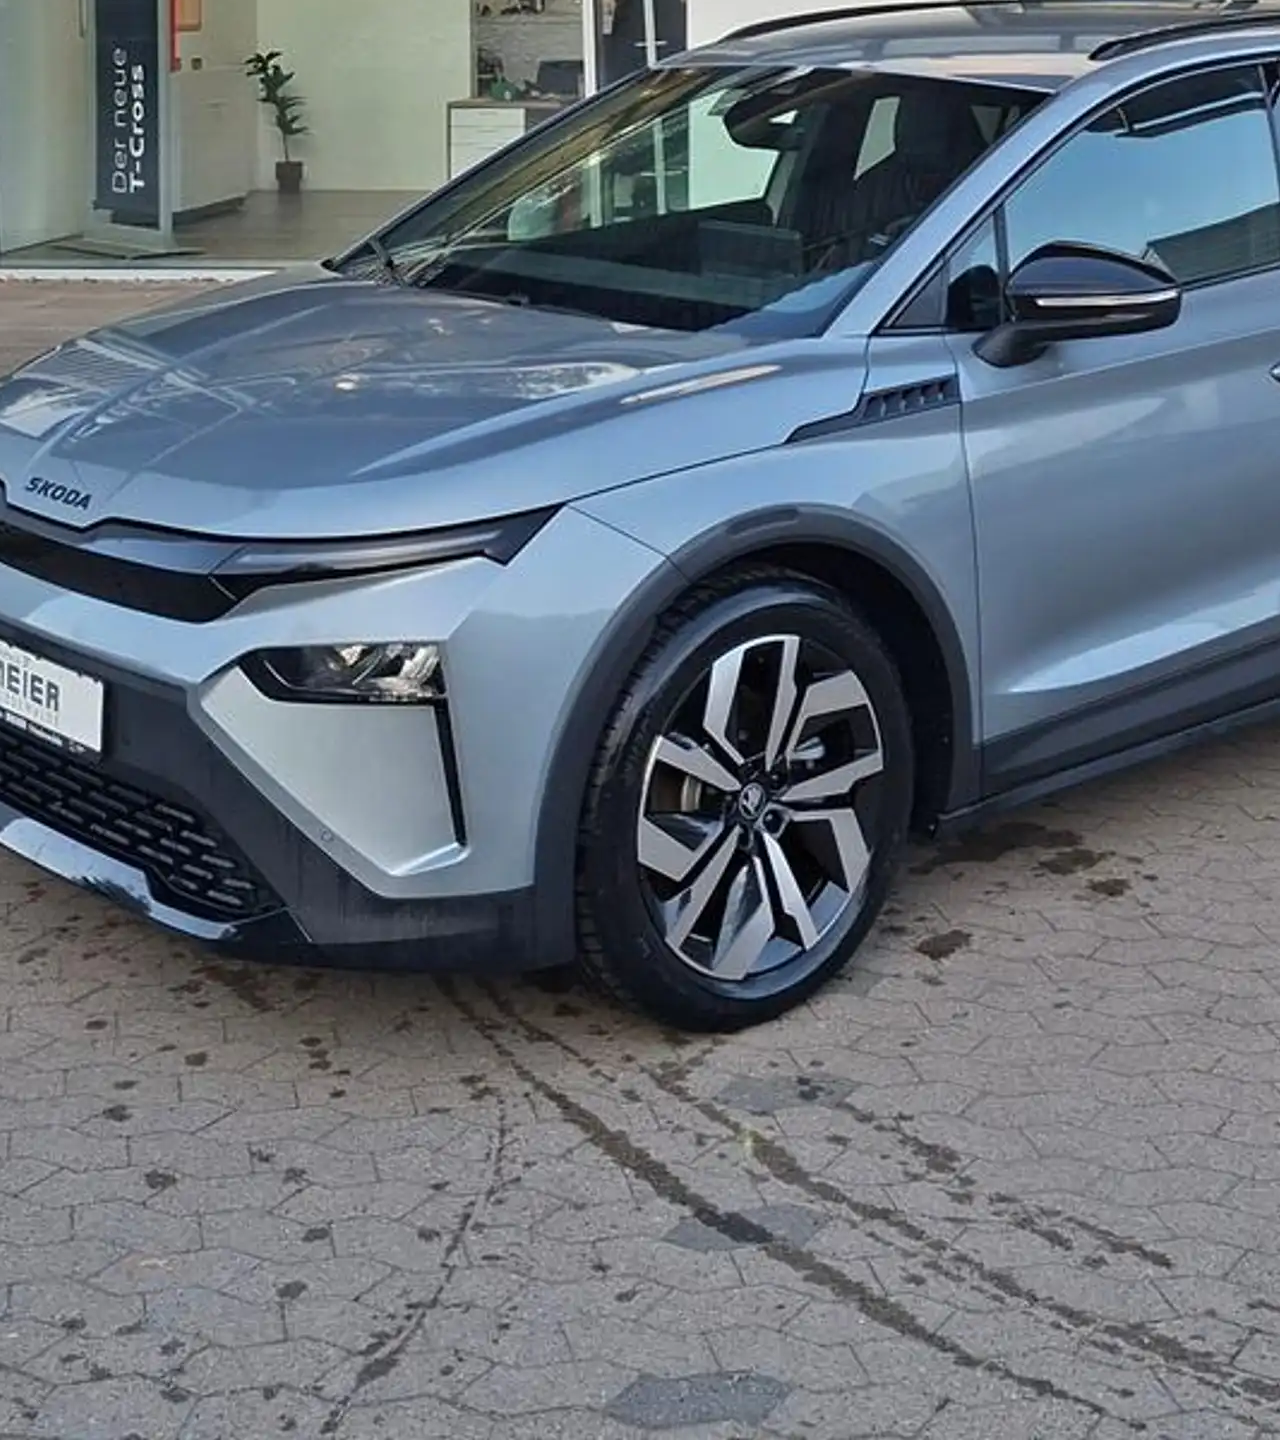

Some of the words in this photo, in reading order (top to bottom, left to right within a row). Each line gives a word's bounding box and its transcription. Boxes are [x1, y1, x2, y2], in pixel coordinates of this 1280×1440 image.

[113, 47, 128, 128] neue
[128, 64, 146, 194] T-Cross
[111, 137, 128, 194] Der
[24, 476, 93, 511] SKODA
